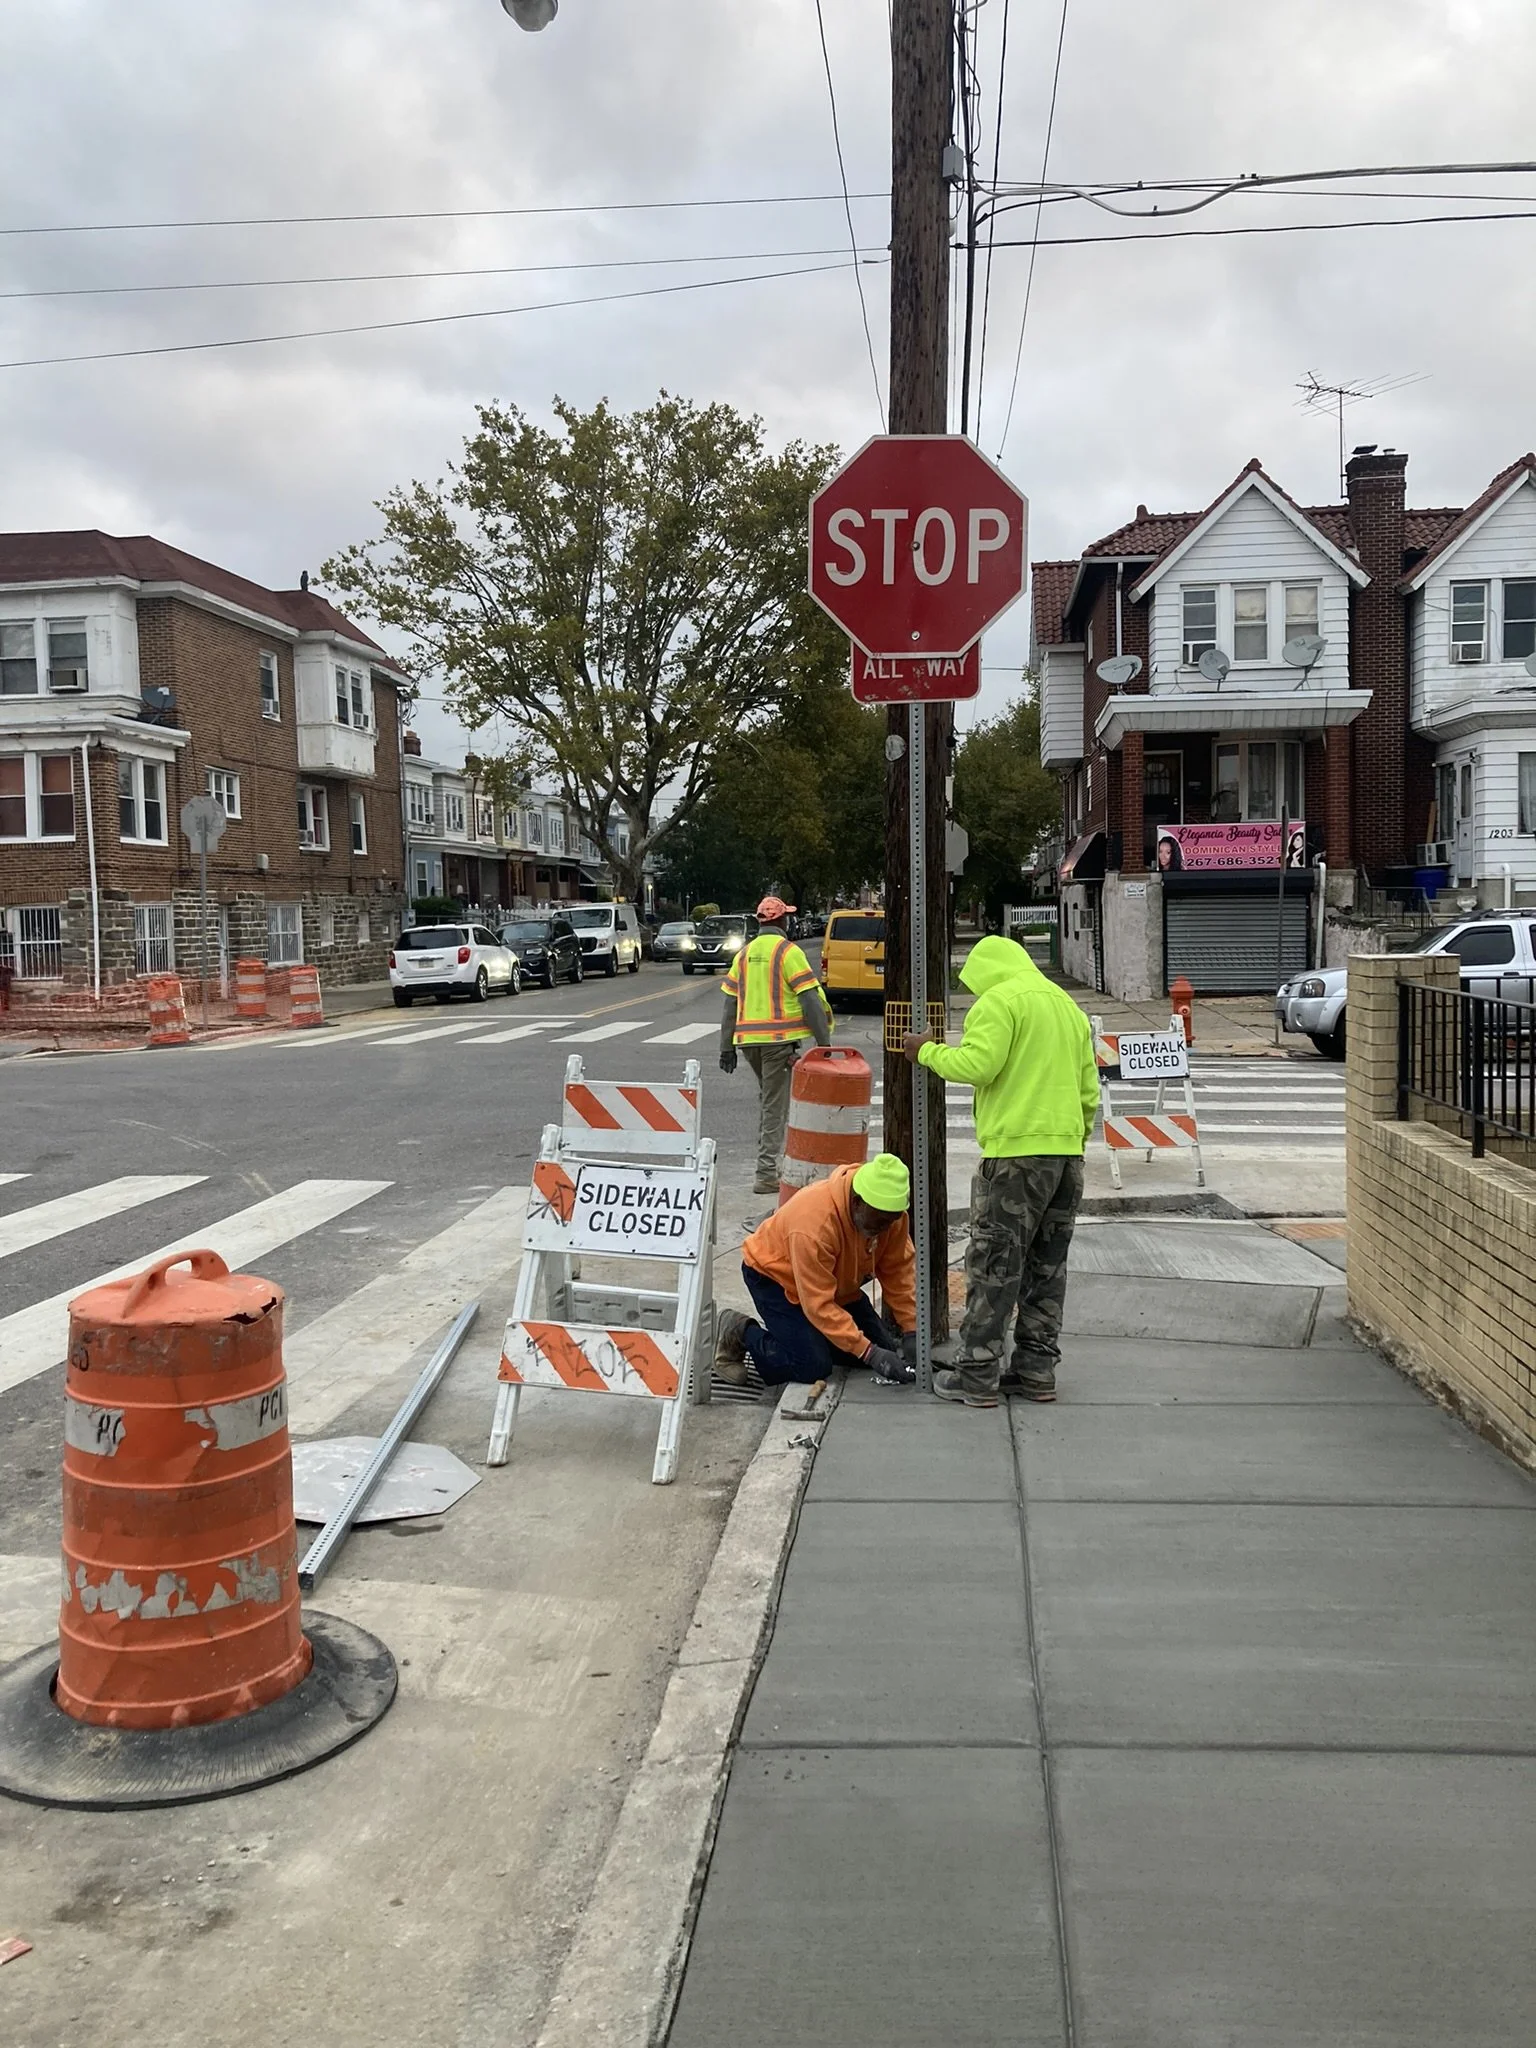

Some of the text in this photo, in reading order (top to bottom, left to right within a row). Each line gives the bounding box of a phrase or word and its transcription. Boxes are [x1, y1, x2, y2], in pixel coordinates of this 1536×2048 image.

[825, 507, 1010, 586] STOP
[863, 653, 969, 679] ALL WAY
[1226, 825, 1261, 843] Beauty
[1489, 829, 1514, 839] 1203
[1185, 846, 1246, 855] DOMINICAN
[1187, 856, 1281, 866] 267-686-3521
[1121, 1040, 1185, 1056] SIDEWALK
[1129, 1055, 1179, 1070] CLOSED
[579, 1183, 705, 1211] SIDEWALK
[588, 1211, 686, 1237] CLOSED
